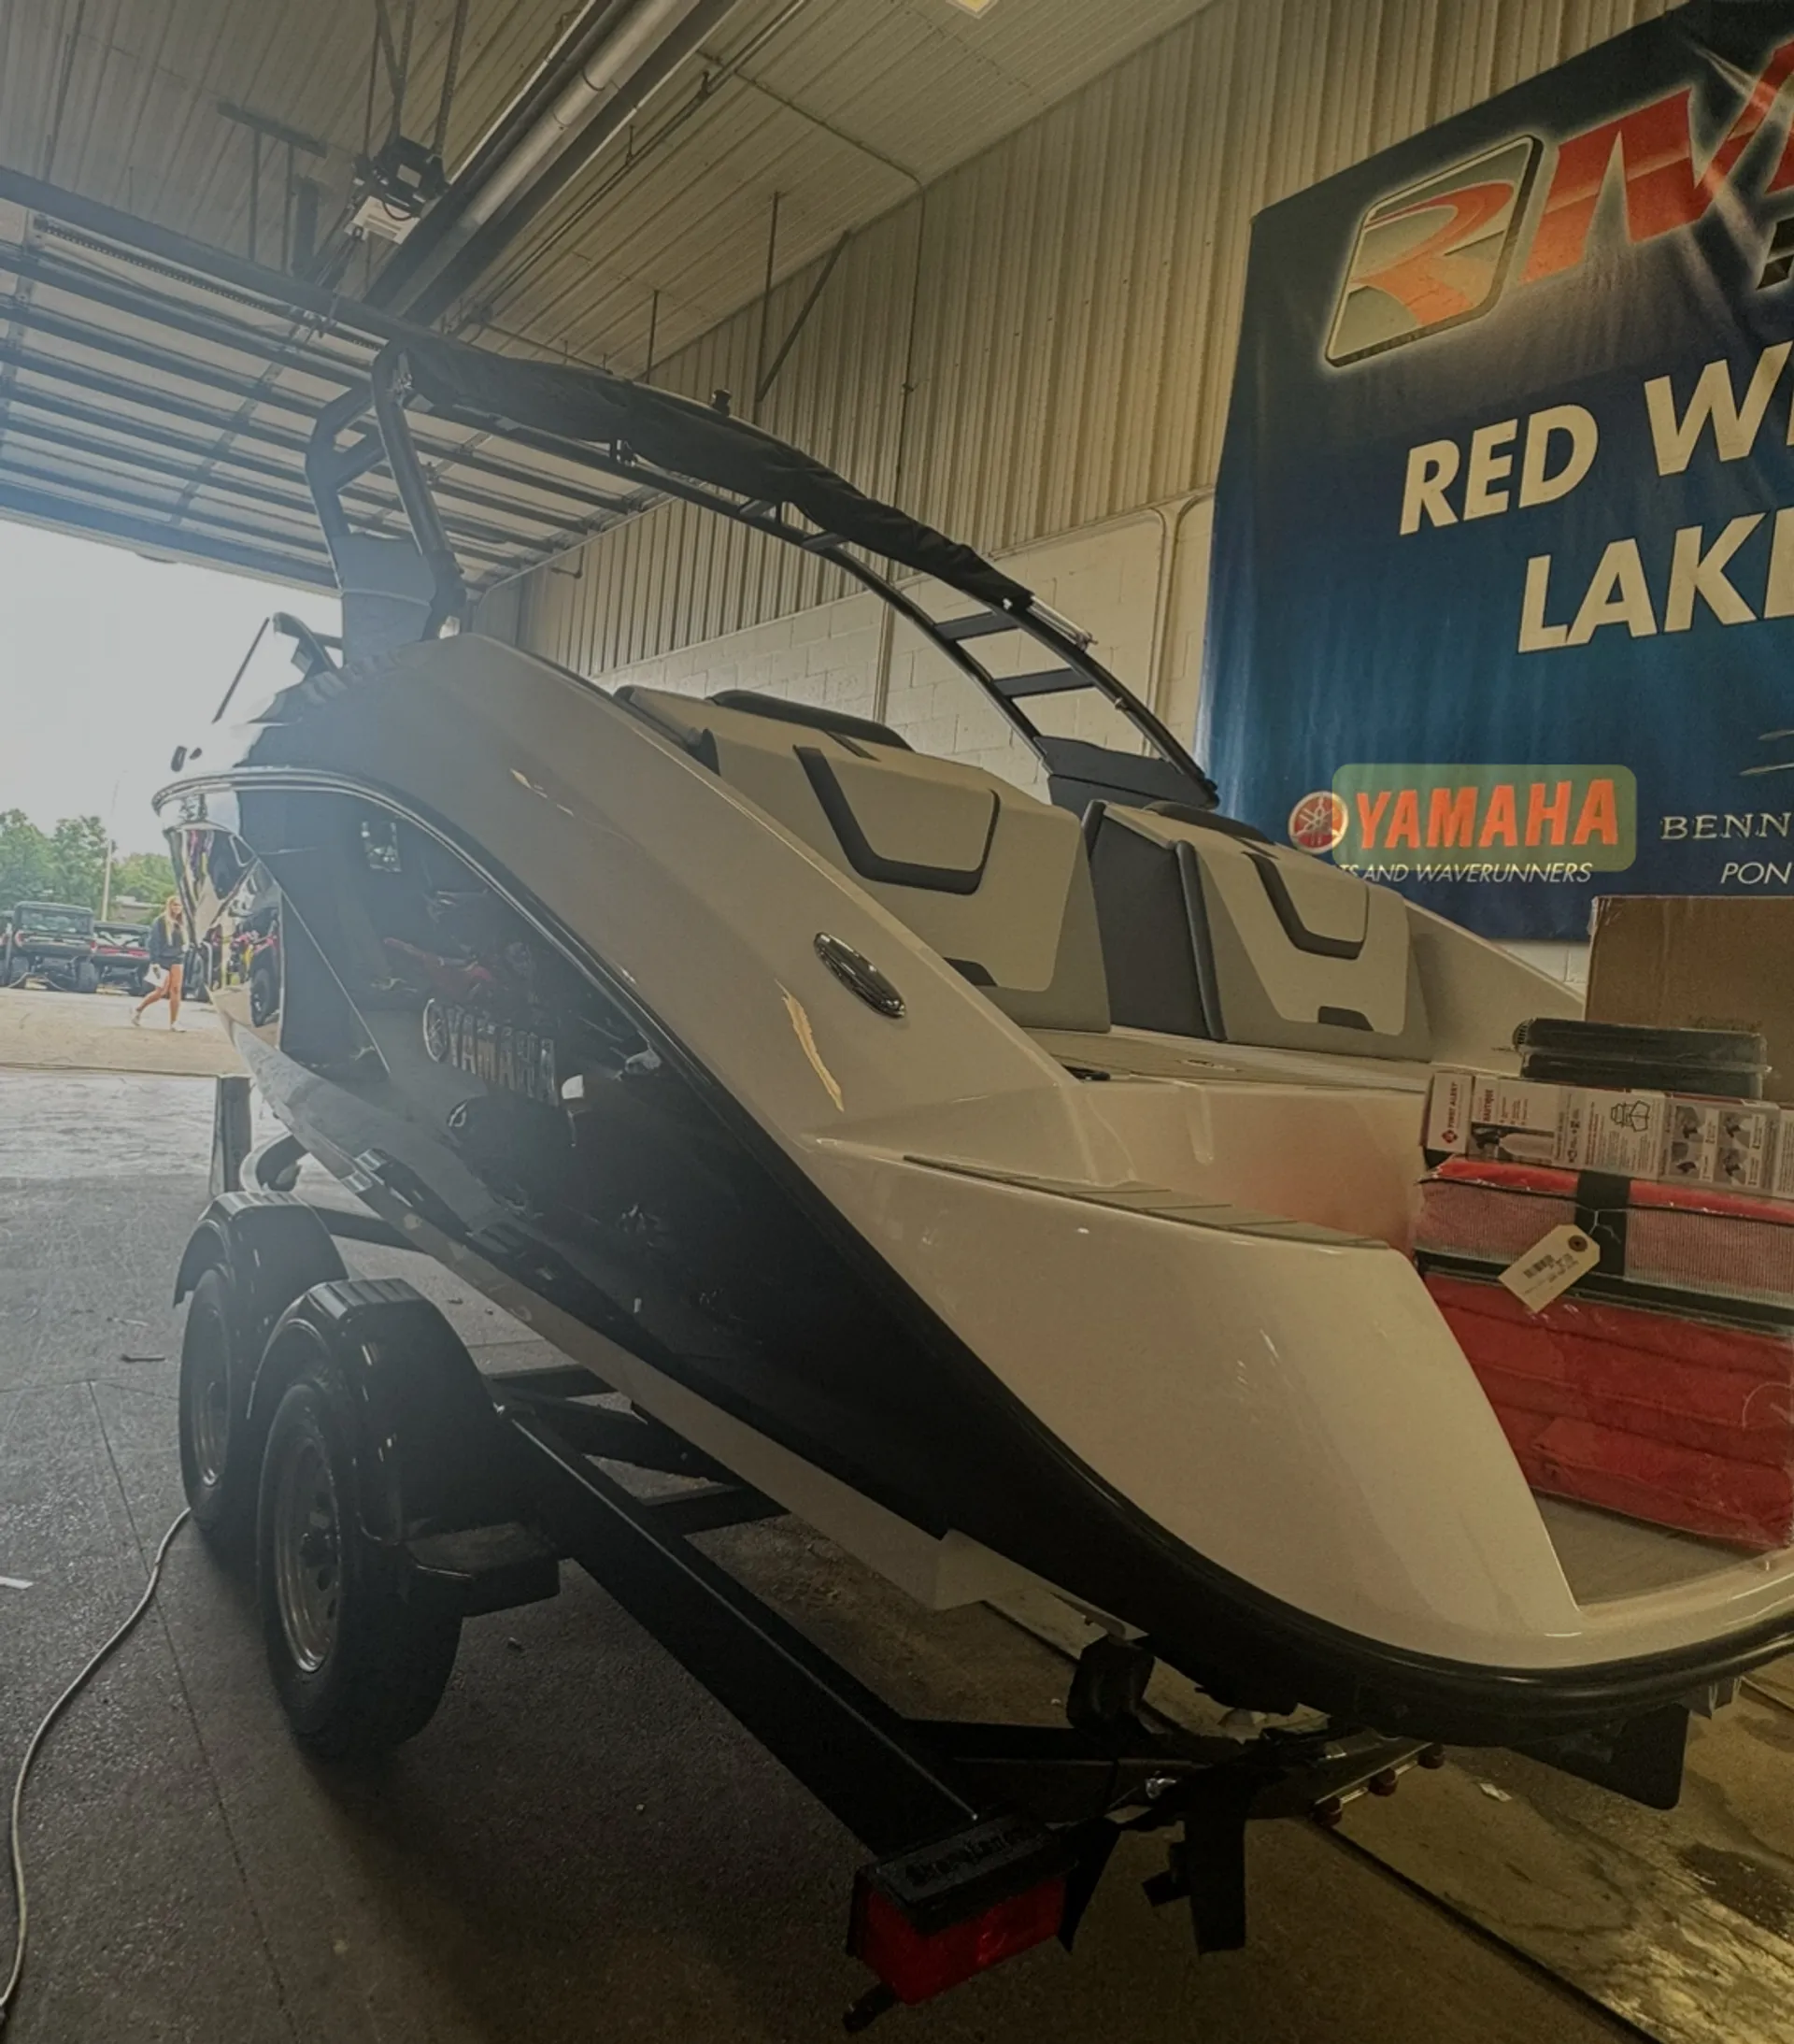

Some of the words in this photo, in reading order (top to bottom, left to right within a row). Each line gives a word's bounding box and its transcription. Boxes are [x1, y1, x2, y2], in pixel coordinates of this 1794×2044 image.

[1400, 403, 1599, 536] RED
[1644, 340, 1794, 478] W
[1357, 779, 1618, 850] YAMAHA
[1363, 864, 1409, 883] AND
[1417, 862, 1593, 883] WAVERUNNERS
[1720, 861, 1793, 885] PON
[447, 1003, 559, 1108] YAMAHA
